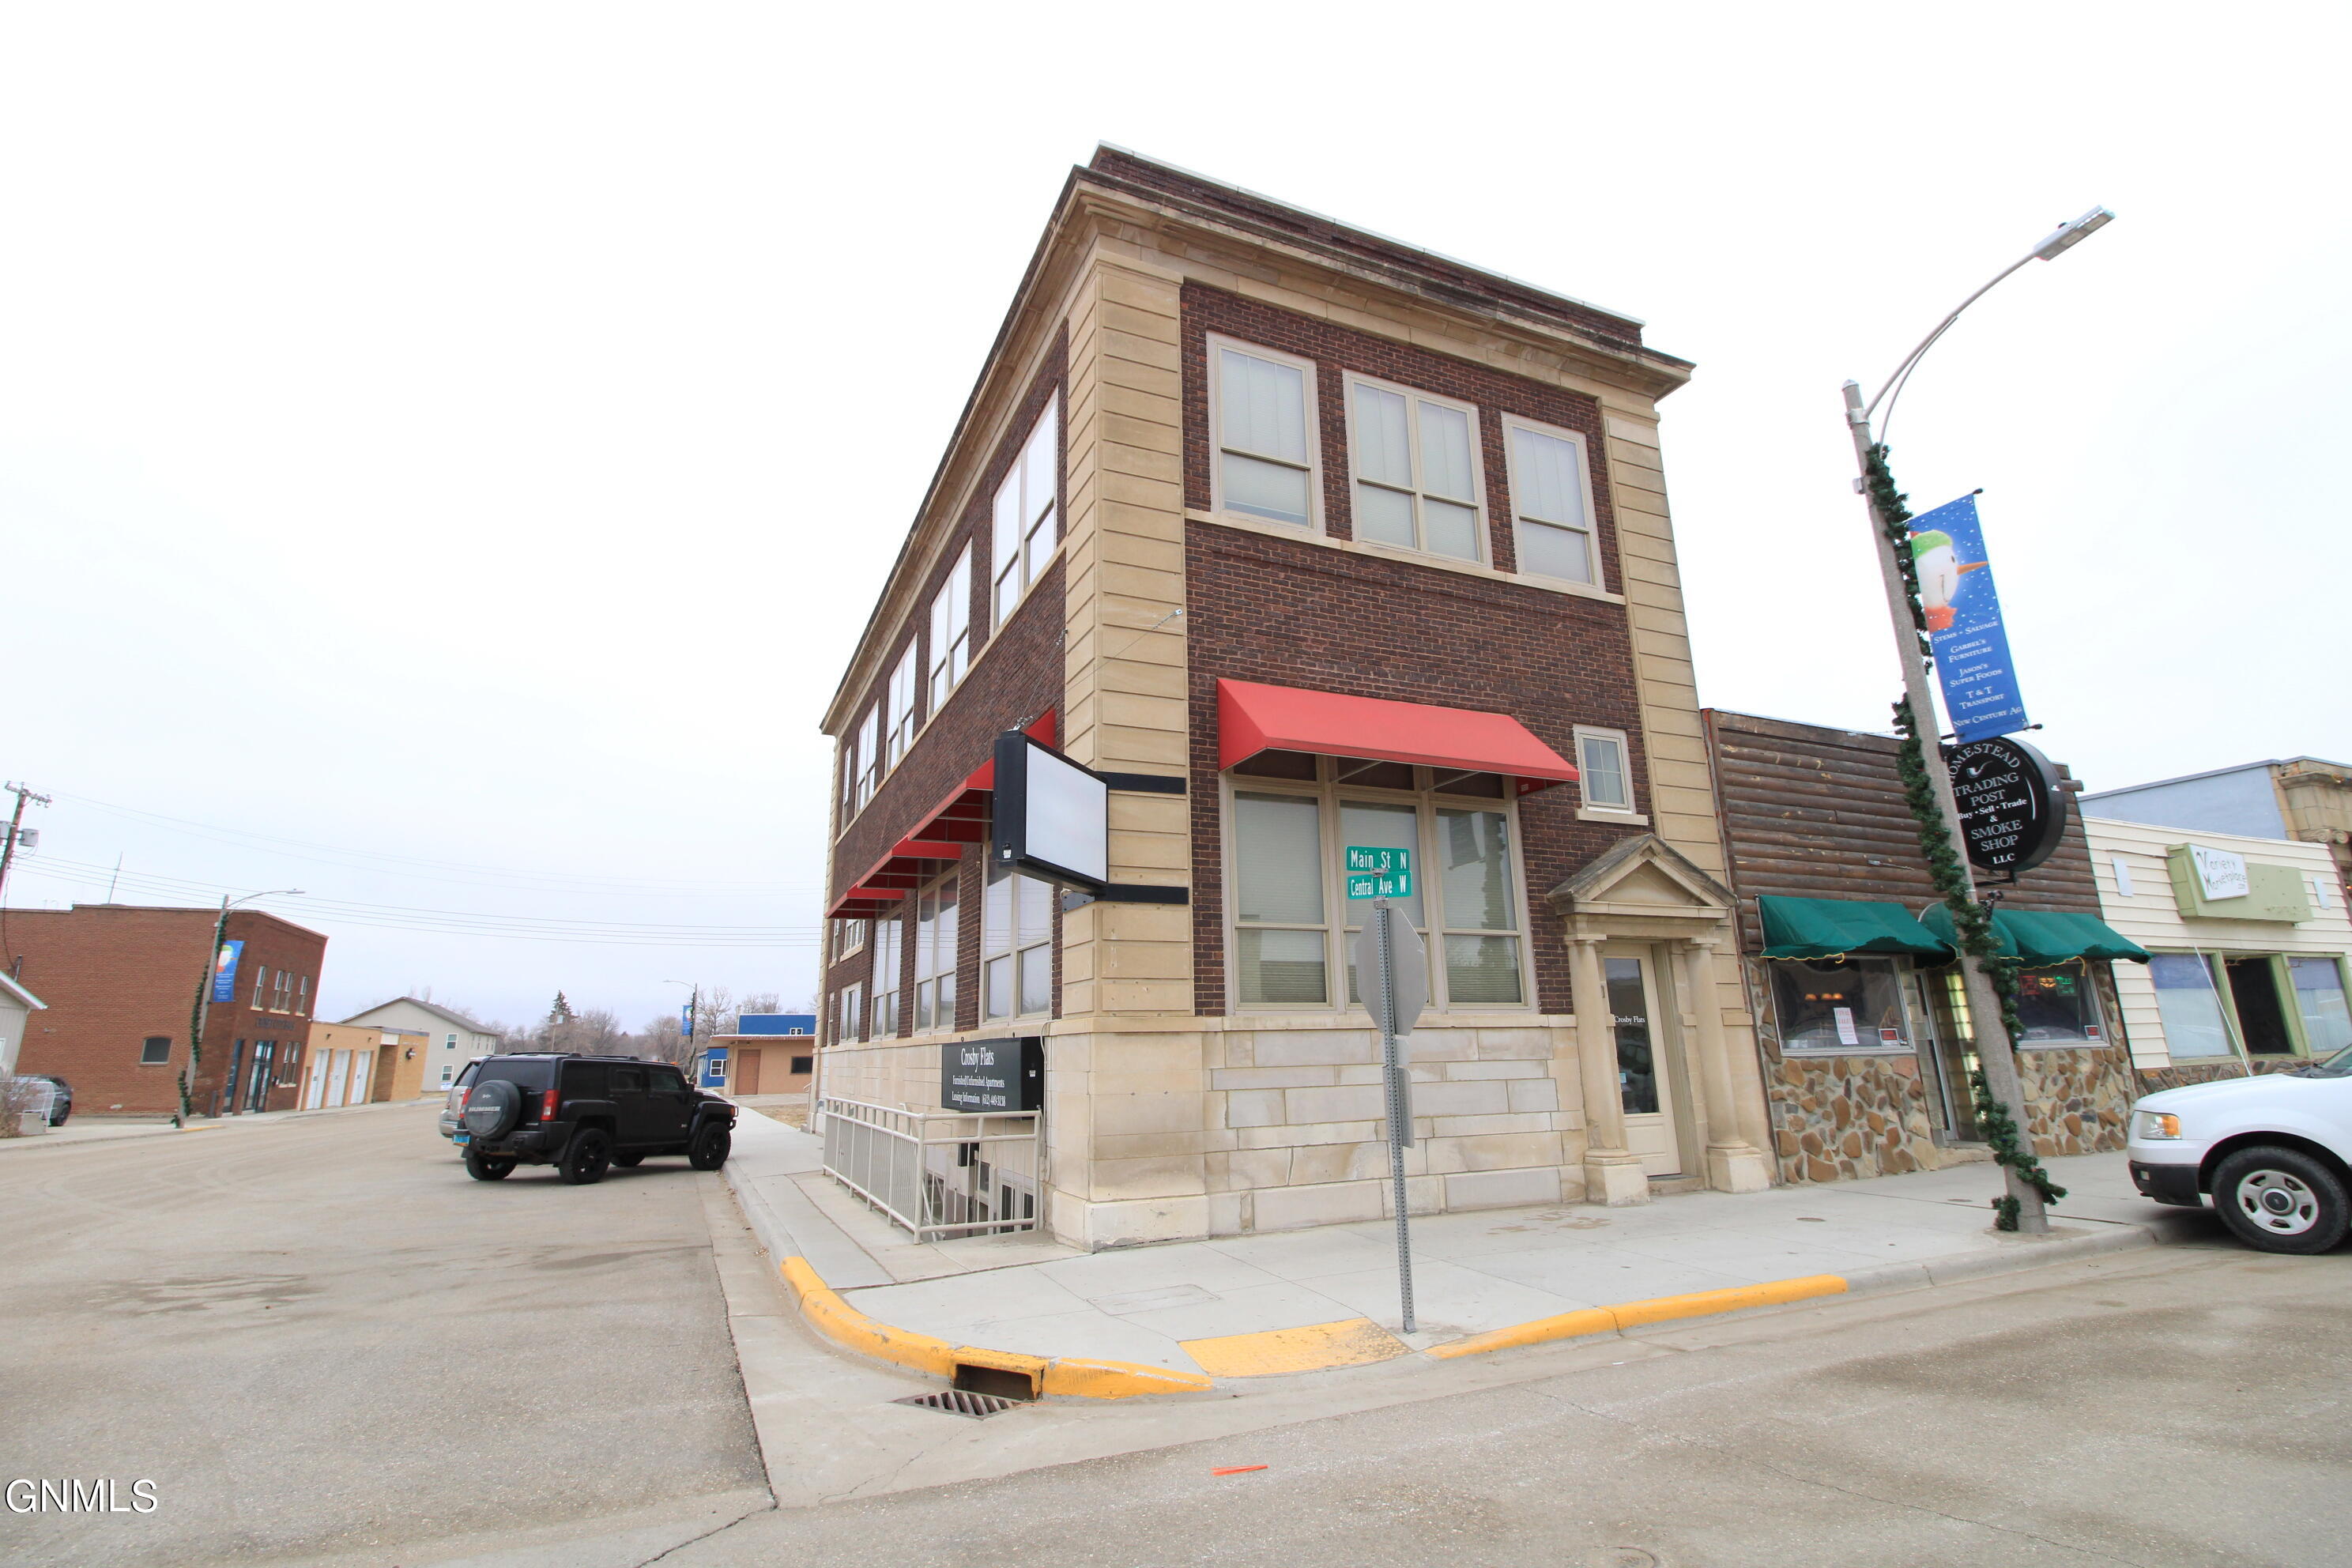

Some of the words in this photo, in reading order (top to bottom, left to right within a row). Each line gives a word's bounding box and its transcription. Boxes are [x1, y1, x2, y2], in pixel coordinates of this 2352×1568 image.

[1959, 693, 2004, 710] TRANSPORT
[1972, 710, 2007, 723] CENTURY
[1953, 772, 2019, 797] TRADING
[1969, 790, 2006, 807] POST
[1980, 805, 1995, 815] Sell
[2000, 798, 2028, 810] Trade
[1971, 820, 2023, 839] SMOKE
[1981, 835, 2018, 851] SHOP
[1351, 850, 1374, 868] Main
[1381, 851, 1390, 869] St
[1400, 852, 1406, 869] N
[1992, 853, 2015, 865] LLC
[1351, 878, 1374, 896] Central
[1379, 878, 1393, 895] Ave
[1399, 875, 1406, 893] W
[1614, 1015, 1632, 1025] Crosby
[961, 1046, 980, 1072] Crosby
[980, 1046, 994, 1065] Flats
[986, 1076, 1005, 1091] Apartments
[952, 1091, 963, 1106] Leasing
[963, 1091, 980, 1104] Information
